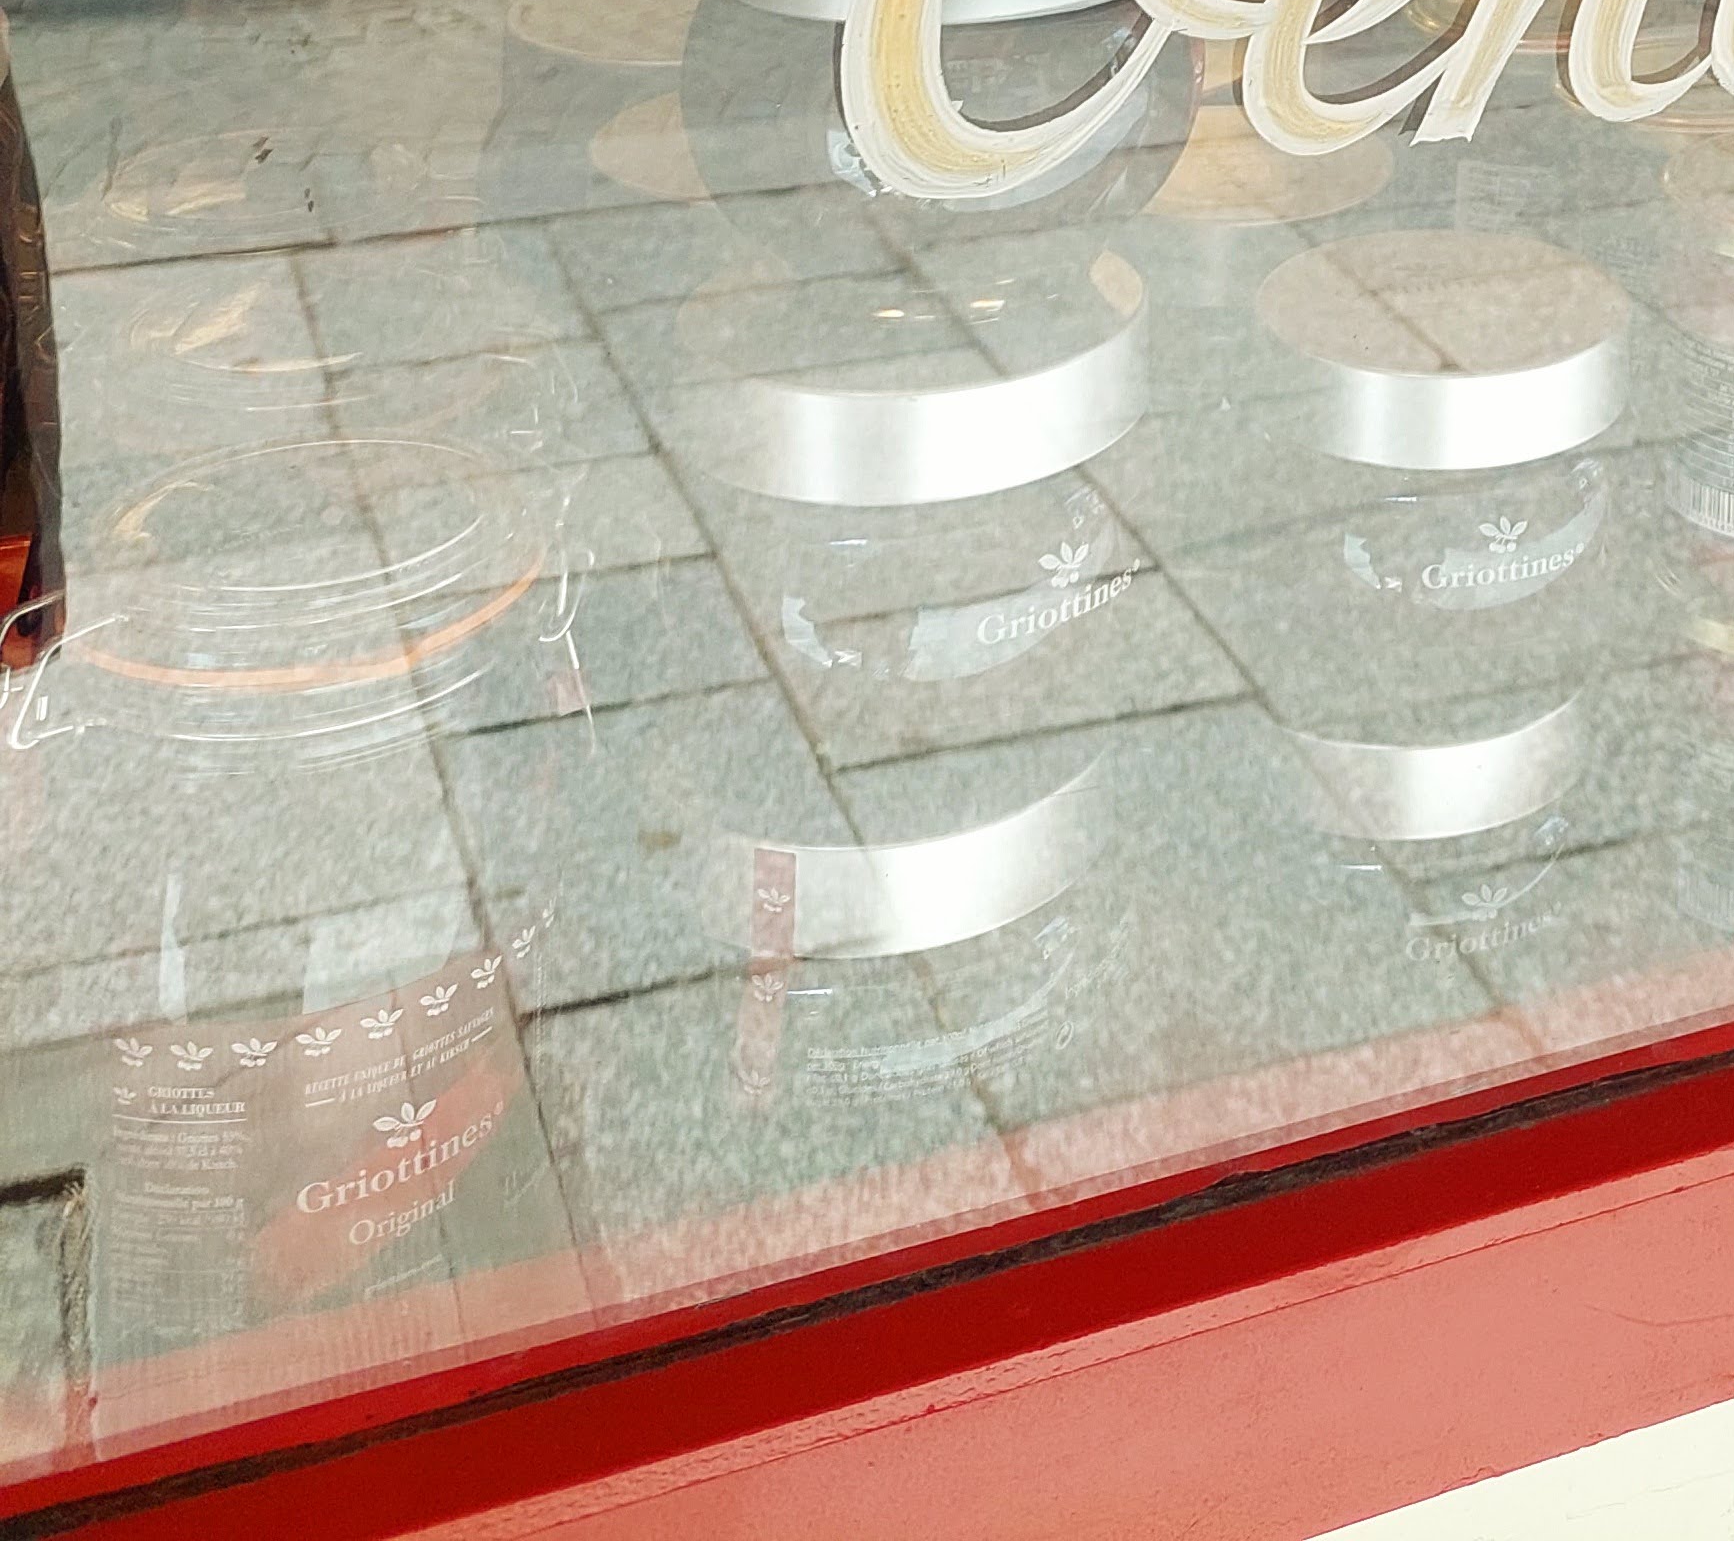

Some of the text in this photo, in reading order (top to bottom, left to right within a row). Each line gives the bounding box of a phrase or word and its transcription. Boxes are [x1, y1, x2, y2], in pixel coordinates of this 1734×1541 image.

[1421, 547, 1576, 591] Griottines
[977, 566, 1136, 646] Griottines
[181, 1101, 247, 1116] LIQUEUR
[305, 1073, 350, 1095] RECETTE
[297, 1112, 494, 1215] Griottines
[350, 1179, 456, 1246] Original
